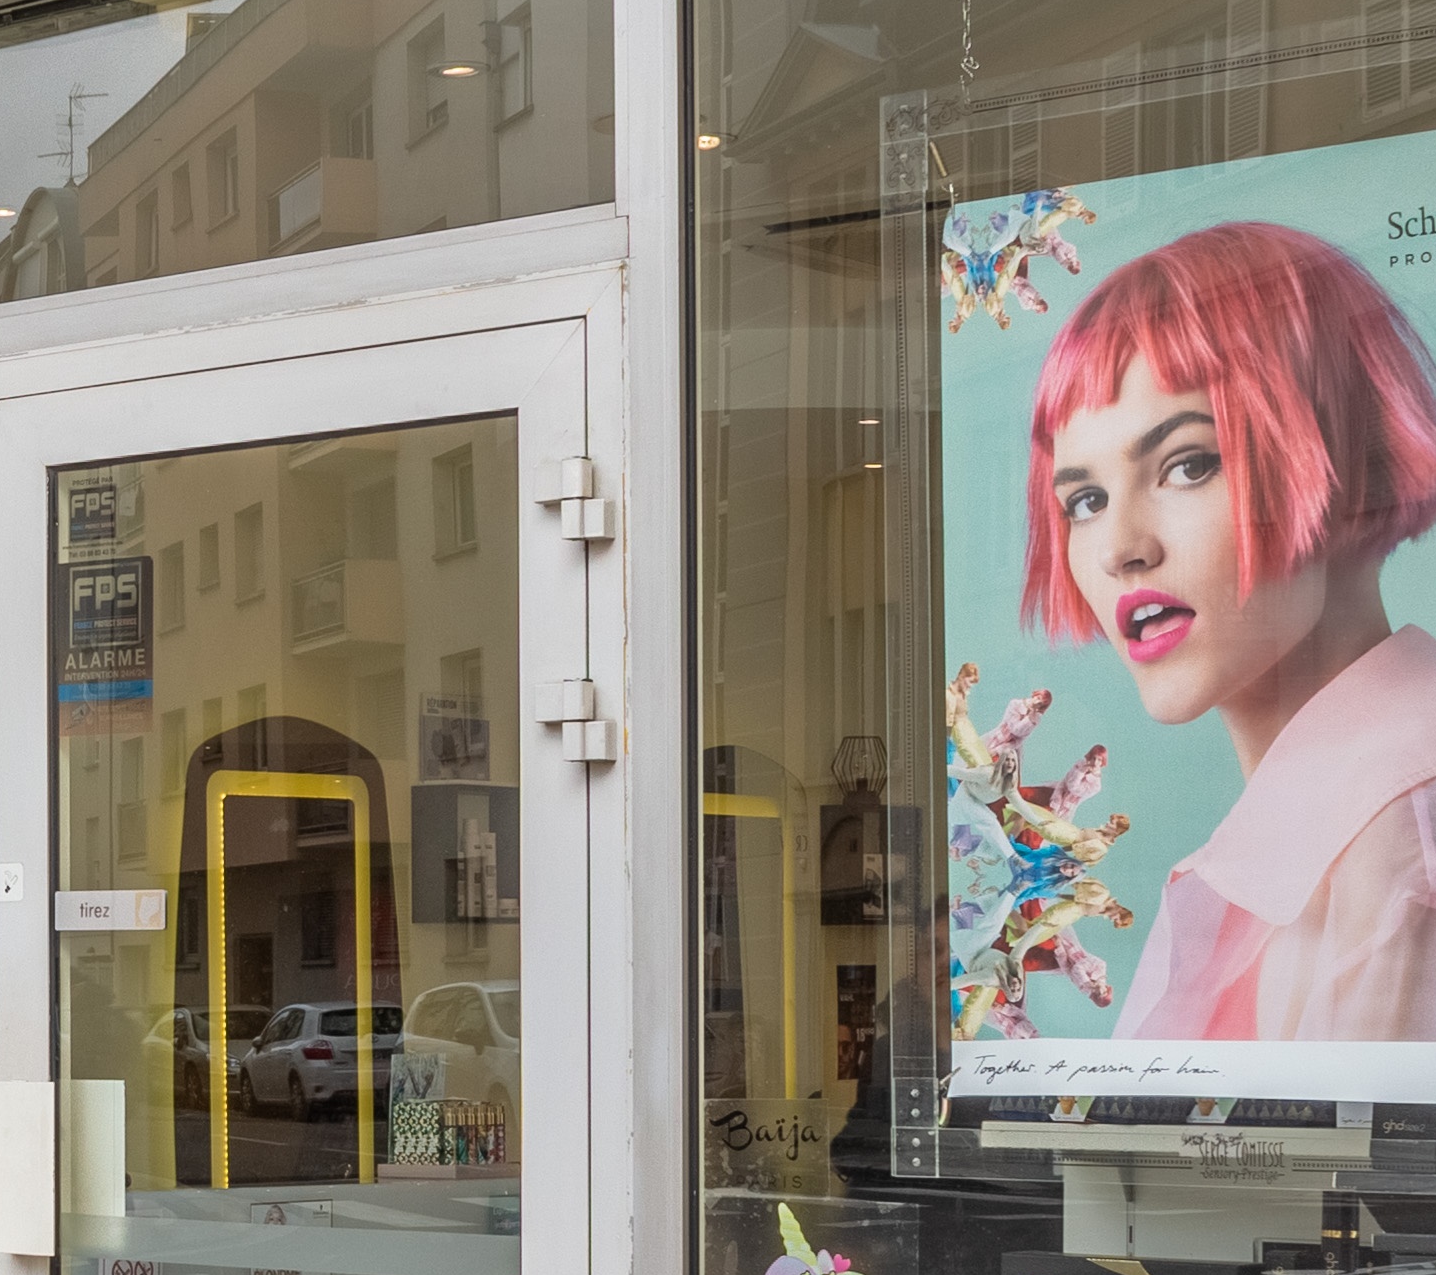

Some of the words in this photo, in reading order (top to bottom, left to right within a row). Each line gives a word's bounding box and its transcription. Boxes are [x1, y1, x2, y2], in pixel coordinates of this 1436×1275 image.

[71, 491, 115, 518] FPS
[74, 574, 137, 611] FPS
[65, 648, 146, 670] ALARME
[64, 670, 118, 682] INTERVENTION
[80, 902, 110, 918] tirez
[1045, 1059, 1068, 1075] A
[1067, 1062, 1135, 1082] passion
[1139, 1056, 1170, 1082] for
[709, 1110, 822, 1161] Baïja
[1199, 1139, 1229, 1166] SERGE
[1236, 1141, 1285, 1168] COMTESSE
[736, 1175, 803, 1192] PARIS
